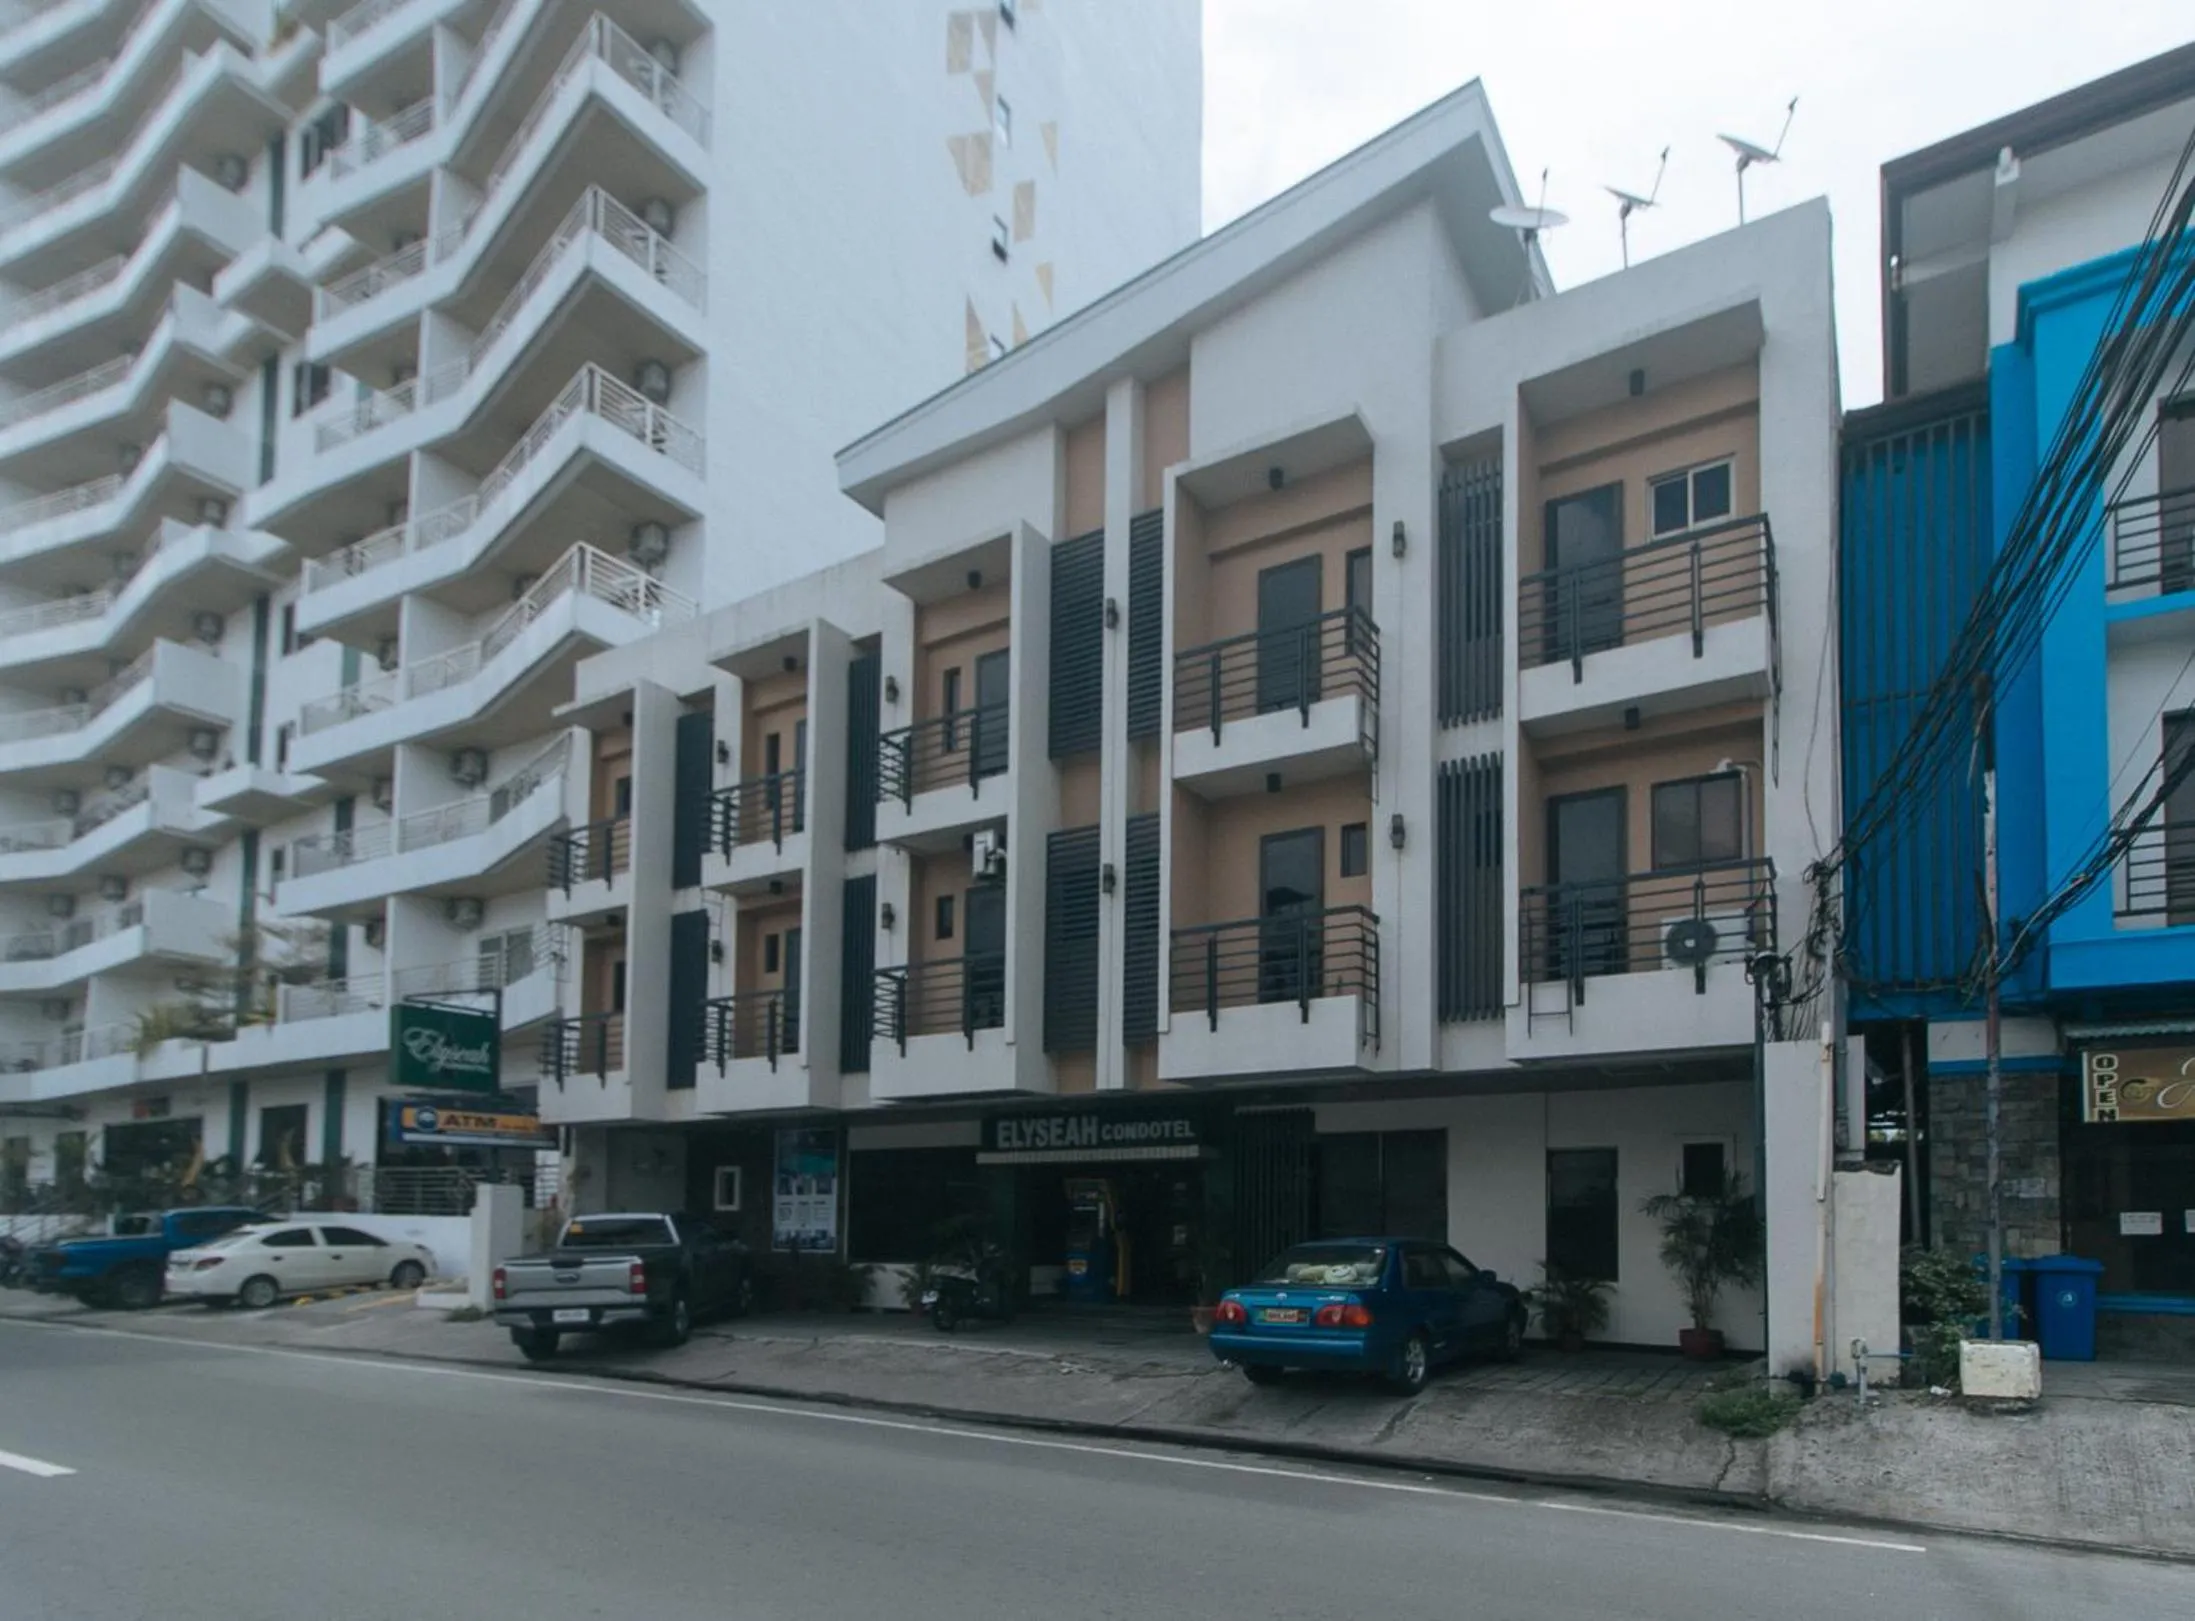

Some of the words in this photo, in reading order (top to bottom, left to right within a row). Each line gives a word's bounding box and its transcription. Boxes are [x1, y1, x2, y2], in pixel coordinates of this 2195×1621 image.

[2093, 1054, 2119, 1122] OPEN
[444, 1114, 497, 1128] ATM
[998, 1117, 1098, 1148] ELYSEAH
[1102, 1120, 1195, 1140] CONDOTEL
